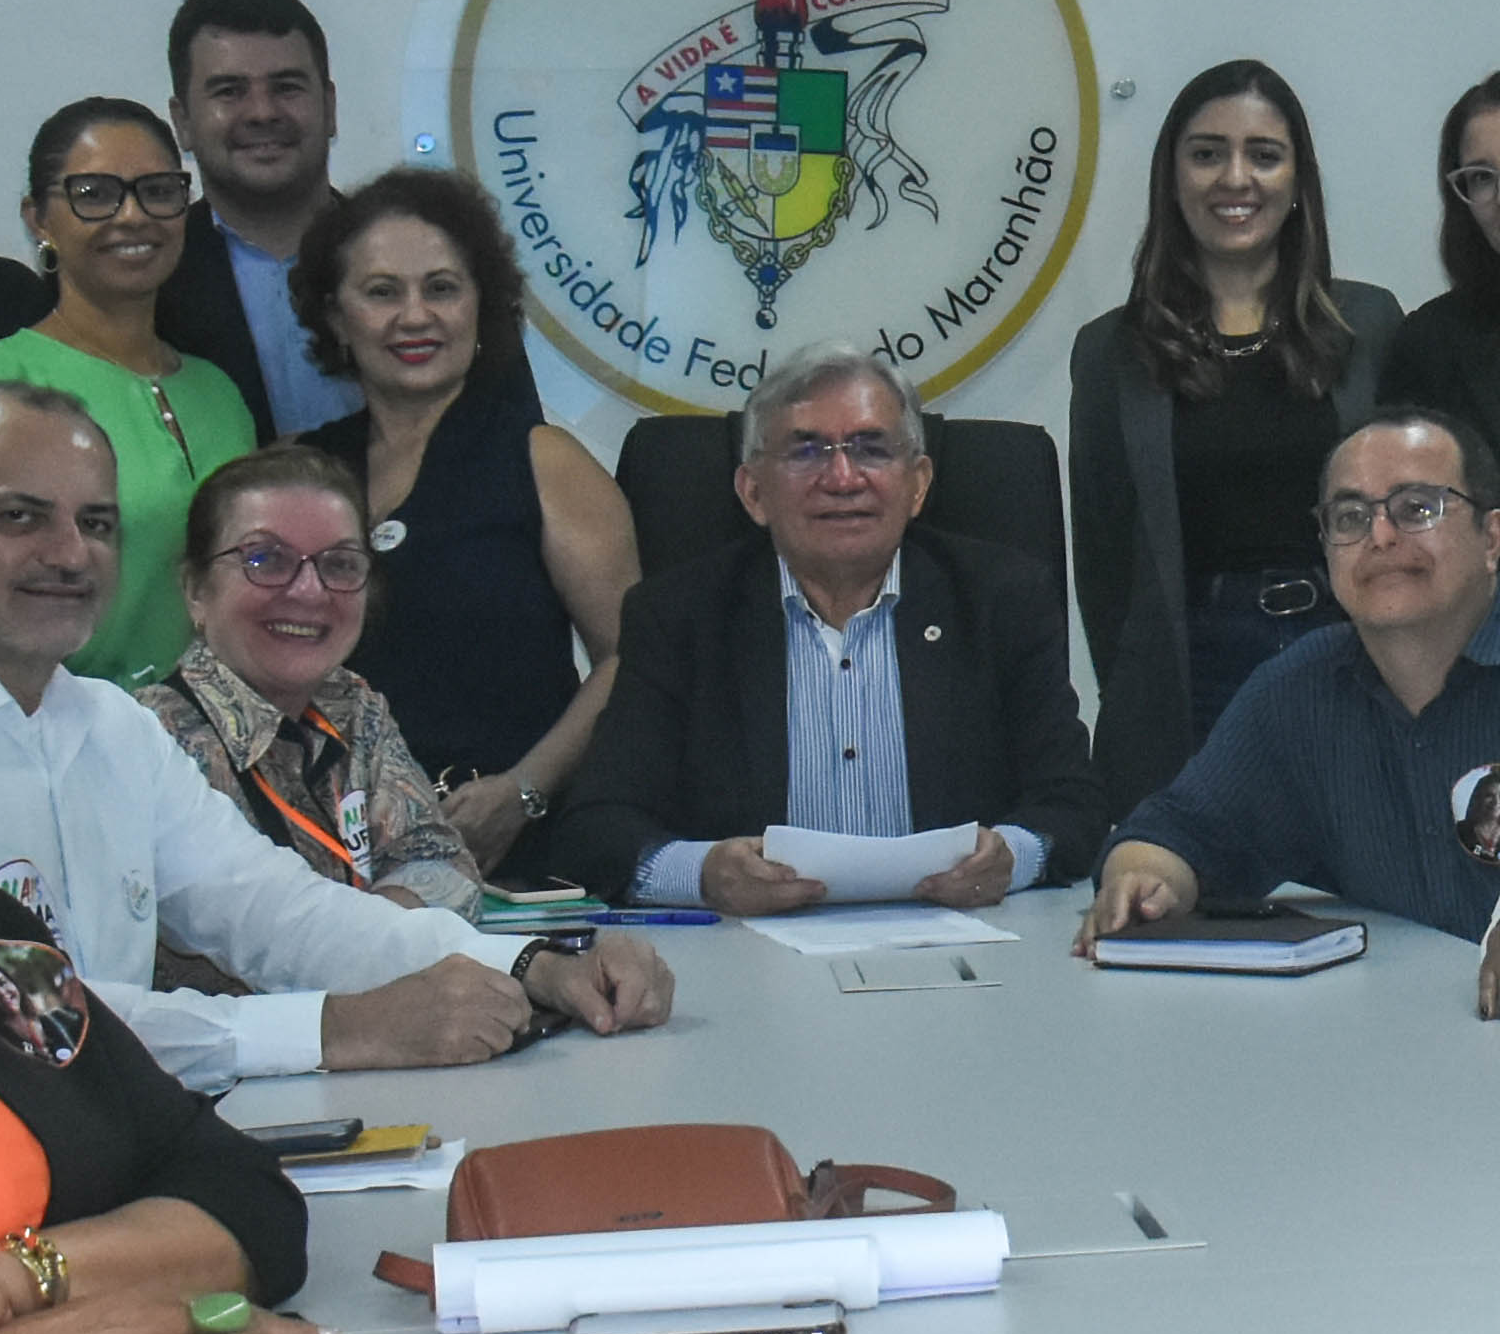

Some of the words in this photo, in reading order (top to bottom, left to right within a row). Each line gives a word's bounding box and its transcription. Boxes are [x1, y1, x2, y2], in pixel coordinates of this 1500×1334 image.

[635, 84, 658, 106] A
[655, 37, 719, 82] VIDA
[718, 19, 739, 46] É
[494, 110, 671, 364] Universidade
[924, 127, 1057, 340] Maranhão
[344, 829, 369, 851] UF
